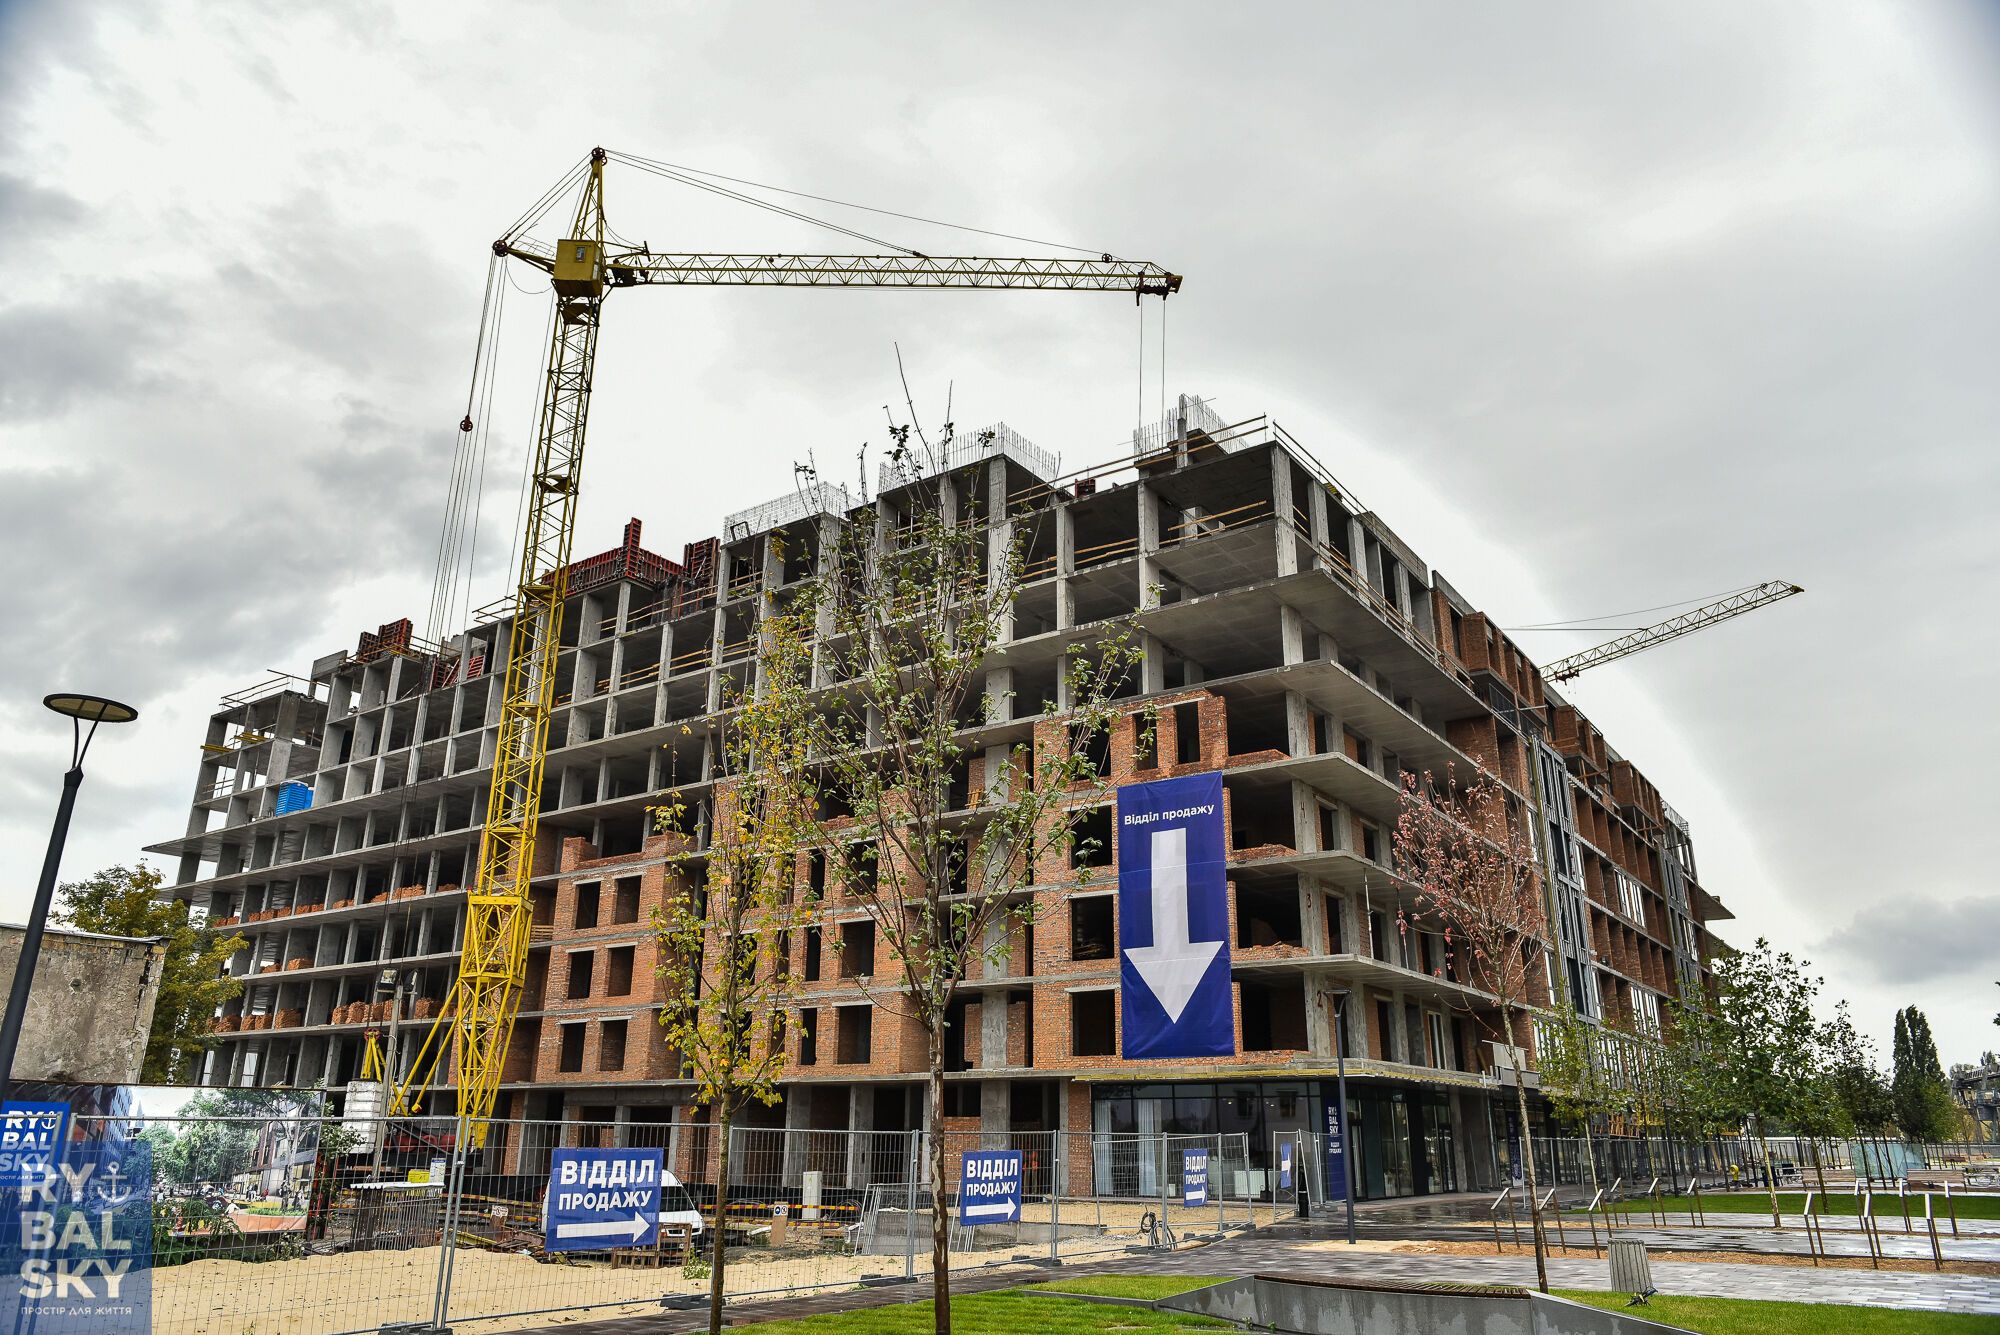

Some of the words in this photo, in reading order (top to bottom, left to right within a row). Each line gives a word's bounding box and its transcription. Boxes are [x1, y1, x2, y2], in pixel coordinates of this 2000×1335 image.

[1124, 812, 1159, 825] Відділ
[1162, 804, 1214, 820] продажу
[1316, 990, 1323, 1008] 2
[5, 1110, 45, 1129] RY
[1, 1132, 51, 1150] BAL
[0, 1152, 50, 1171] SKY
[966, 1159, 1018, 1180] ВІДДІЛ
[1185, 1156, 1206, 1172] ВІДДІЛ
[560, 1160, 655, 1189] ВІДДІЛ
[966, 1181, 1017, 1197] ПРОДАЖУ
[558, 1190, 652, 1212] ПРОДАЖУ
